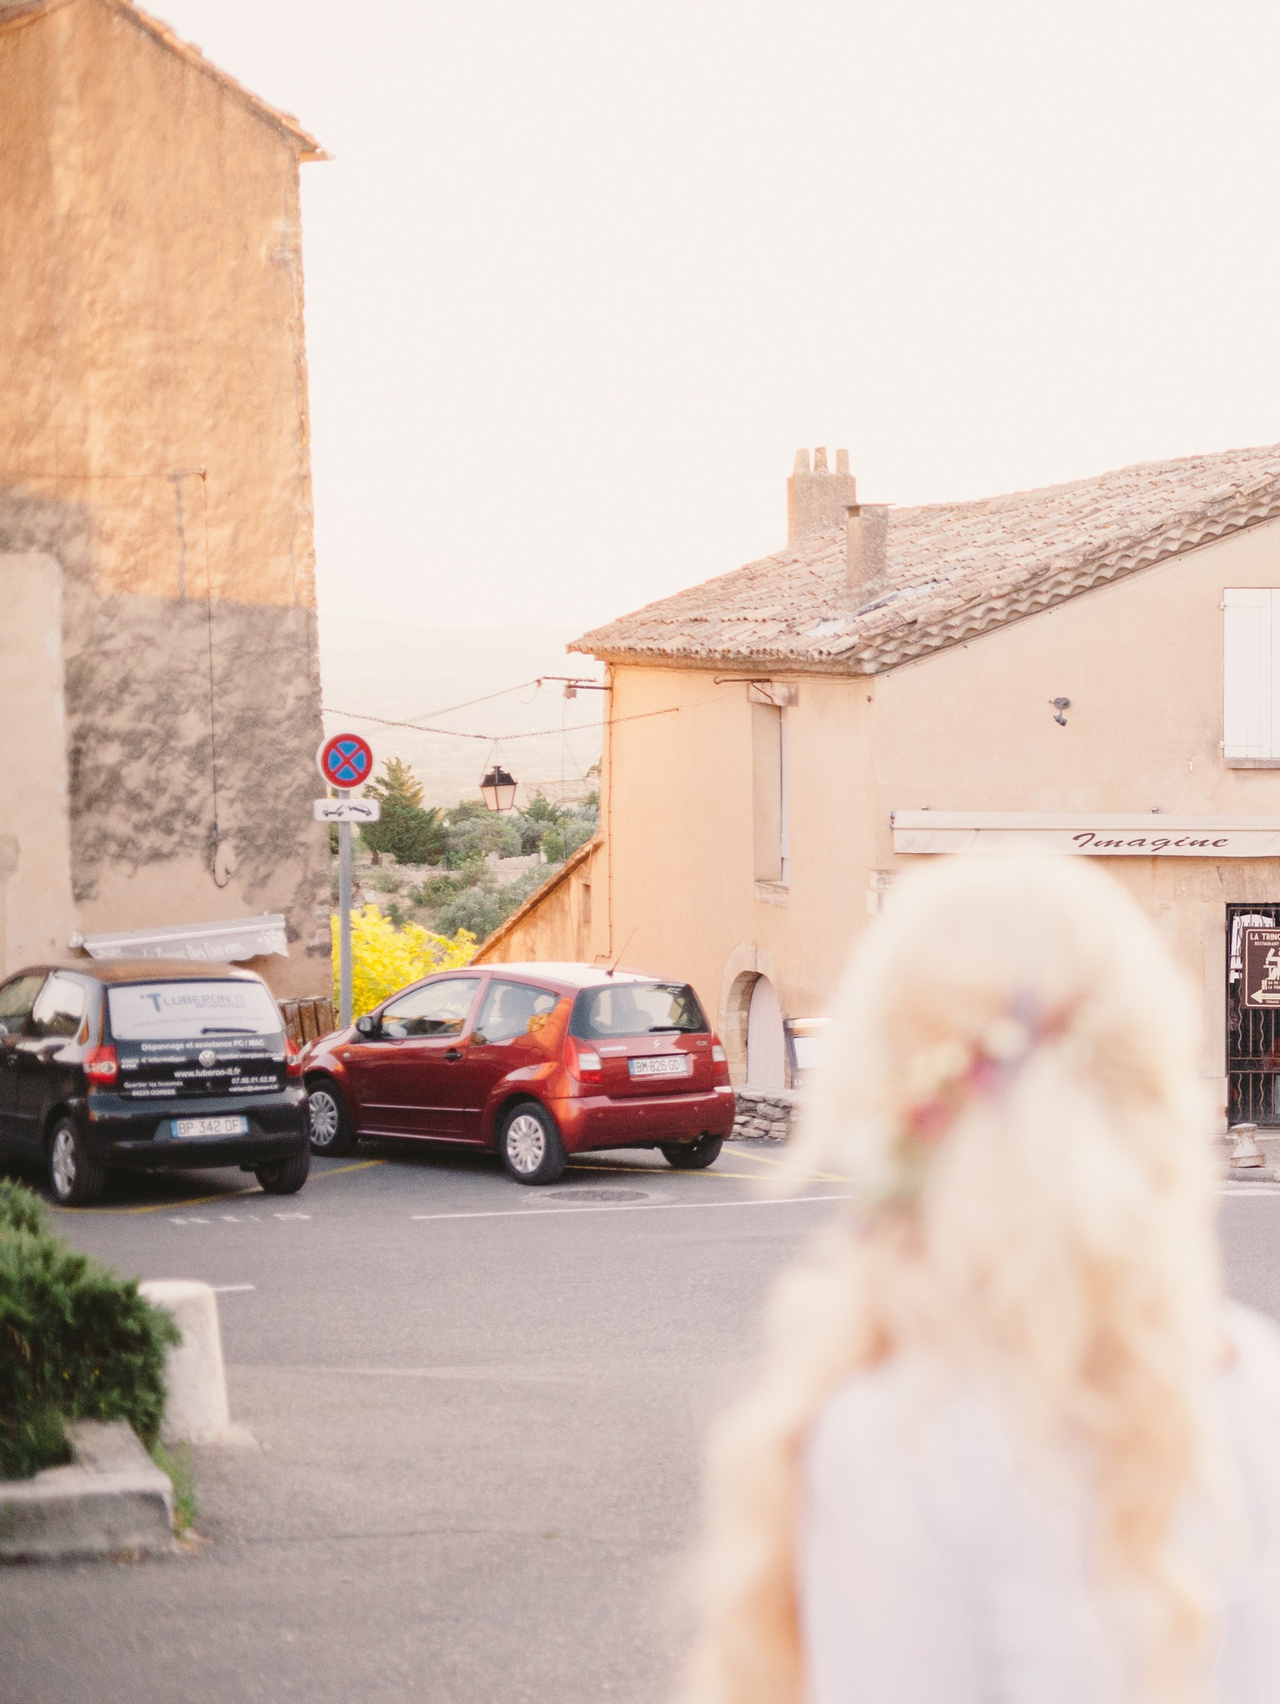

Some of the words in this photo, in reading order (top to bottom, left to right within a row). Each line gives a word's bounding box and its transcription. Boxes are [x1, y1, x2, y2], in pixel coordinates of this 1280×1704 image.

[1072, 832, 1229, 852] Imagine
[1250, 933, 1259, 941] LA
[162, 994, 231, 1007] LUBERON
[141, 1041, 185, 1051] Dépannage
[185, 1041, 194, 1049] et
[194, 1040, 233, 1049] assistance
[174, 1067, 242, 1079] www.luberon-it.fr
